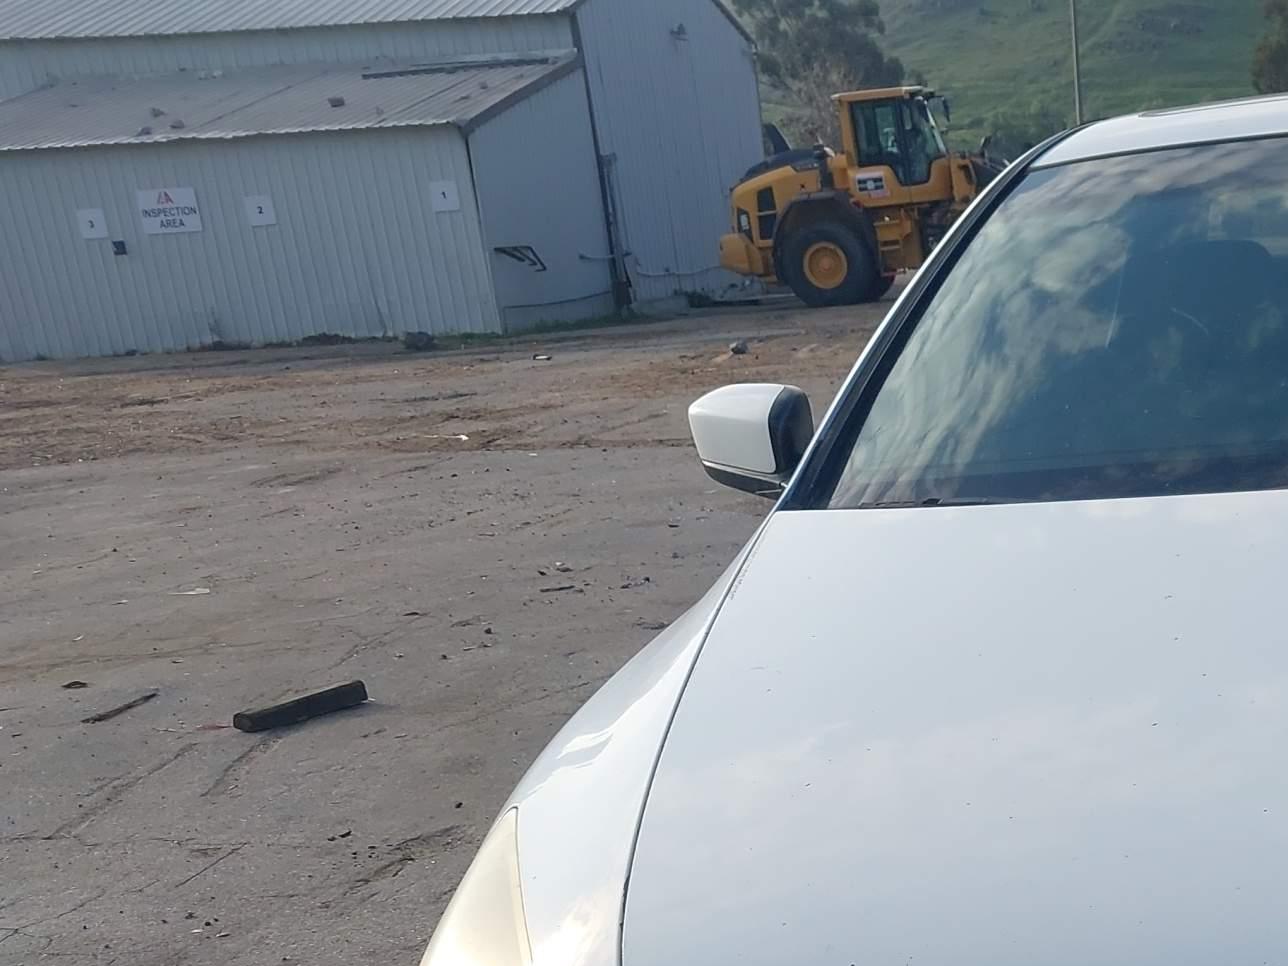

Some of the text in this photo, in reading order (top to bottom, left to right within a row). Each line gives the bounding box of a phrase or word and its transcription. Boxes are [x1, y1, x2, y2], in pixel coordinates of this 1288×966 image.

[142, 206, 197, 218] INSPECTION
[256, 205, 264, 215] 2
[160, 219, 185, 228] AREA
